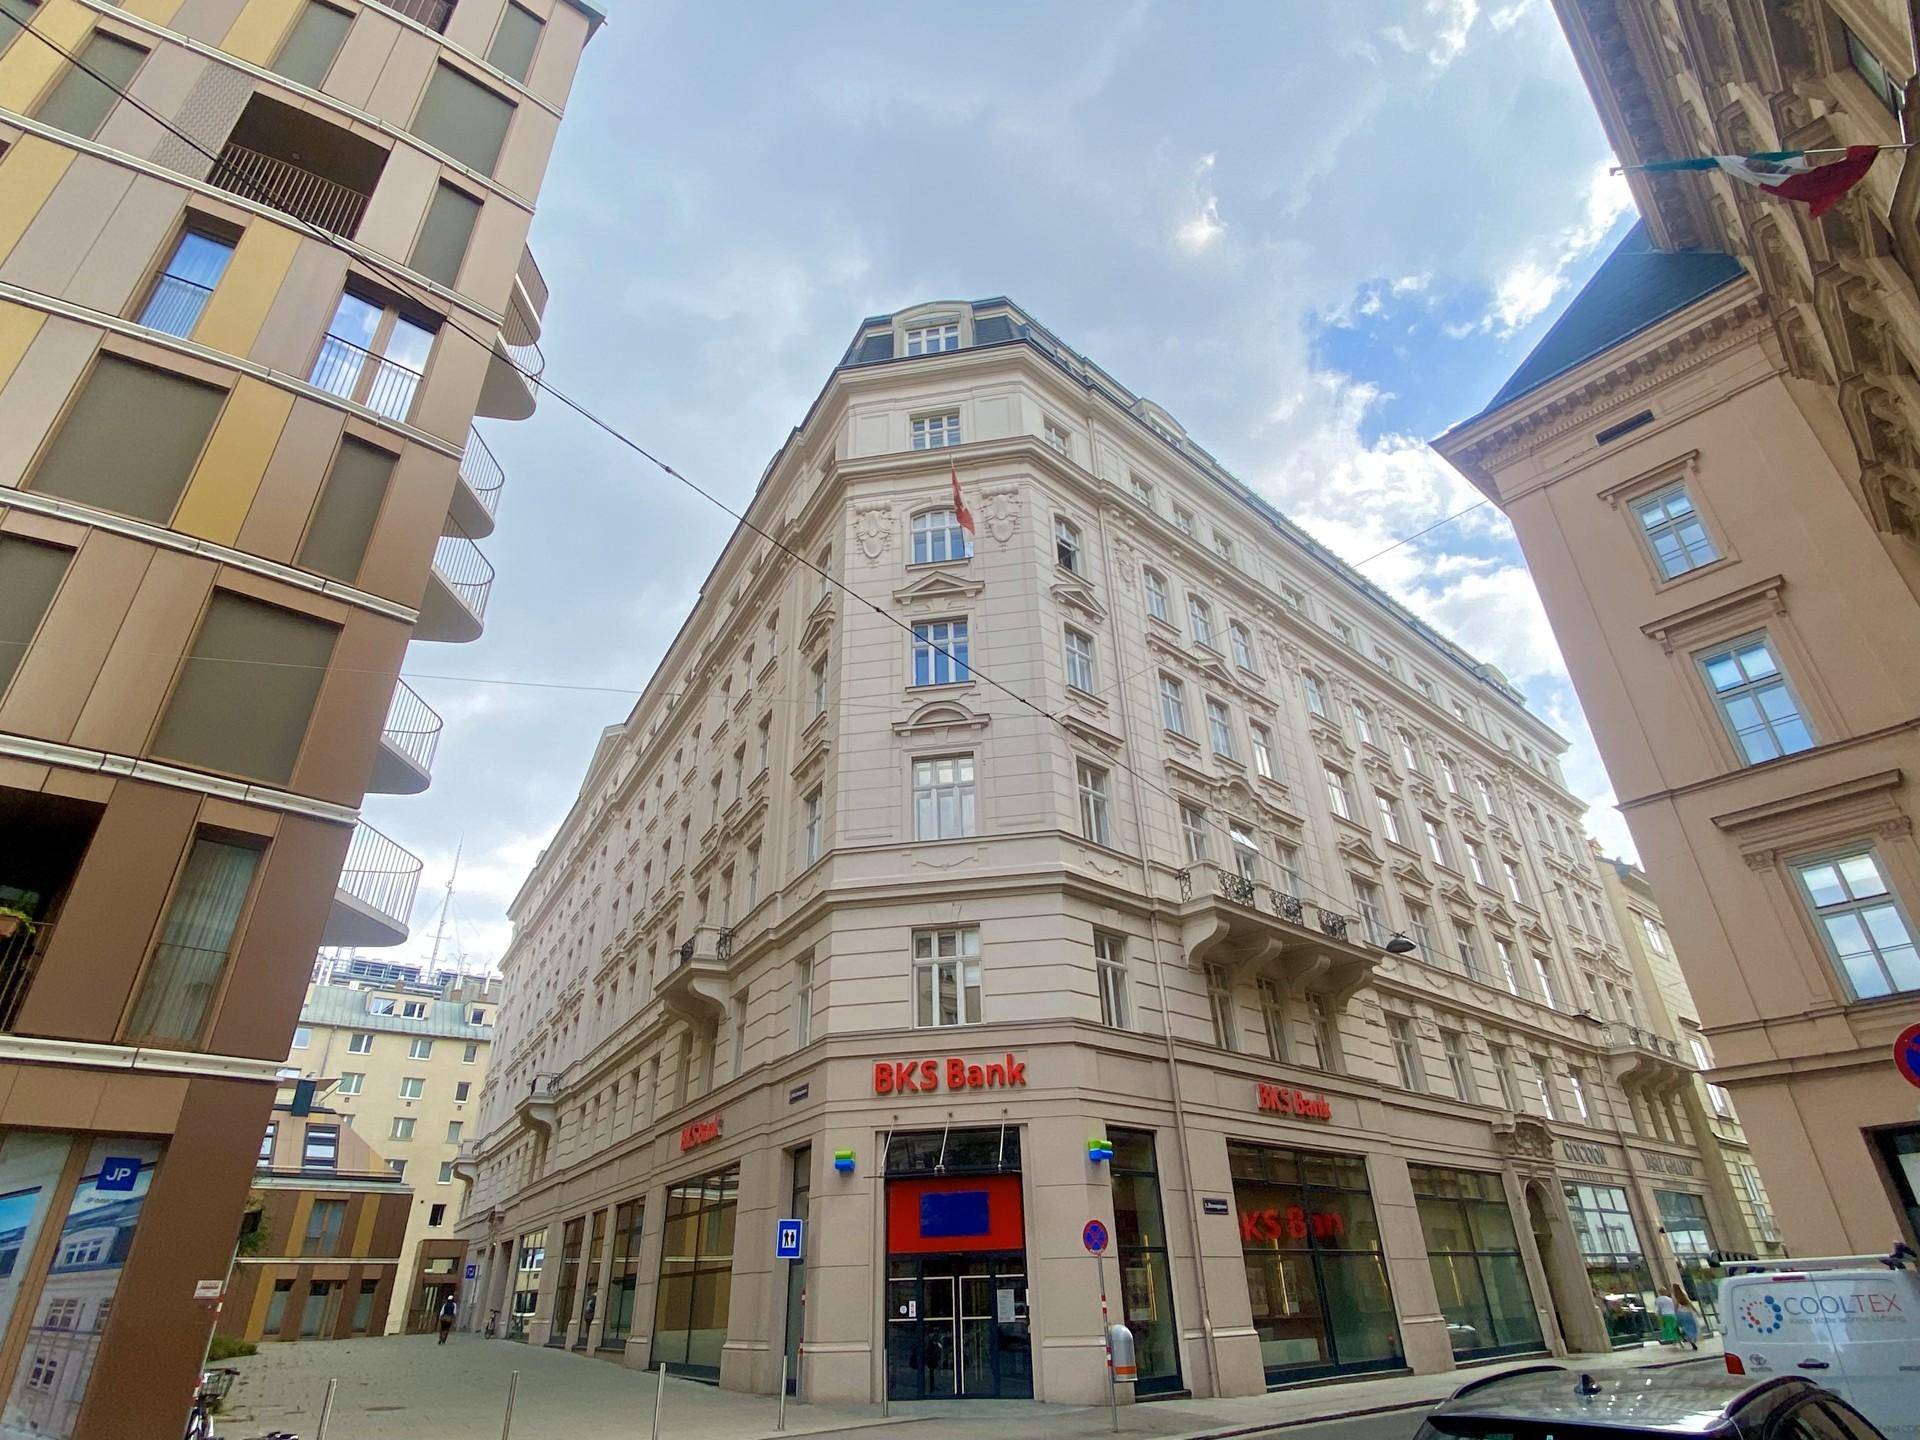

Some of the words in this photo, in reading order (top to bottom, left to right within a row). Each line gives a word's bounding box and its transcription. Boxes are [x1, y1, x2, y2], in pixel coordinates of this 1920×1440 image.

[874, 1060, 938, 1095] BKS
[946, 1053, 1027, 1090] Bank
[1256, 1081, 1292, 1113] BKS
[1293, 1089, 1333, 1120] Bank
[1561, 1139, 1608, 1166] COCOON
[105, 1167, 132, 1181] JP
[1239, 1208, 1281, 1241] KS
[1783, 1293, 1903, 1316] COOLTEX
